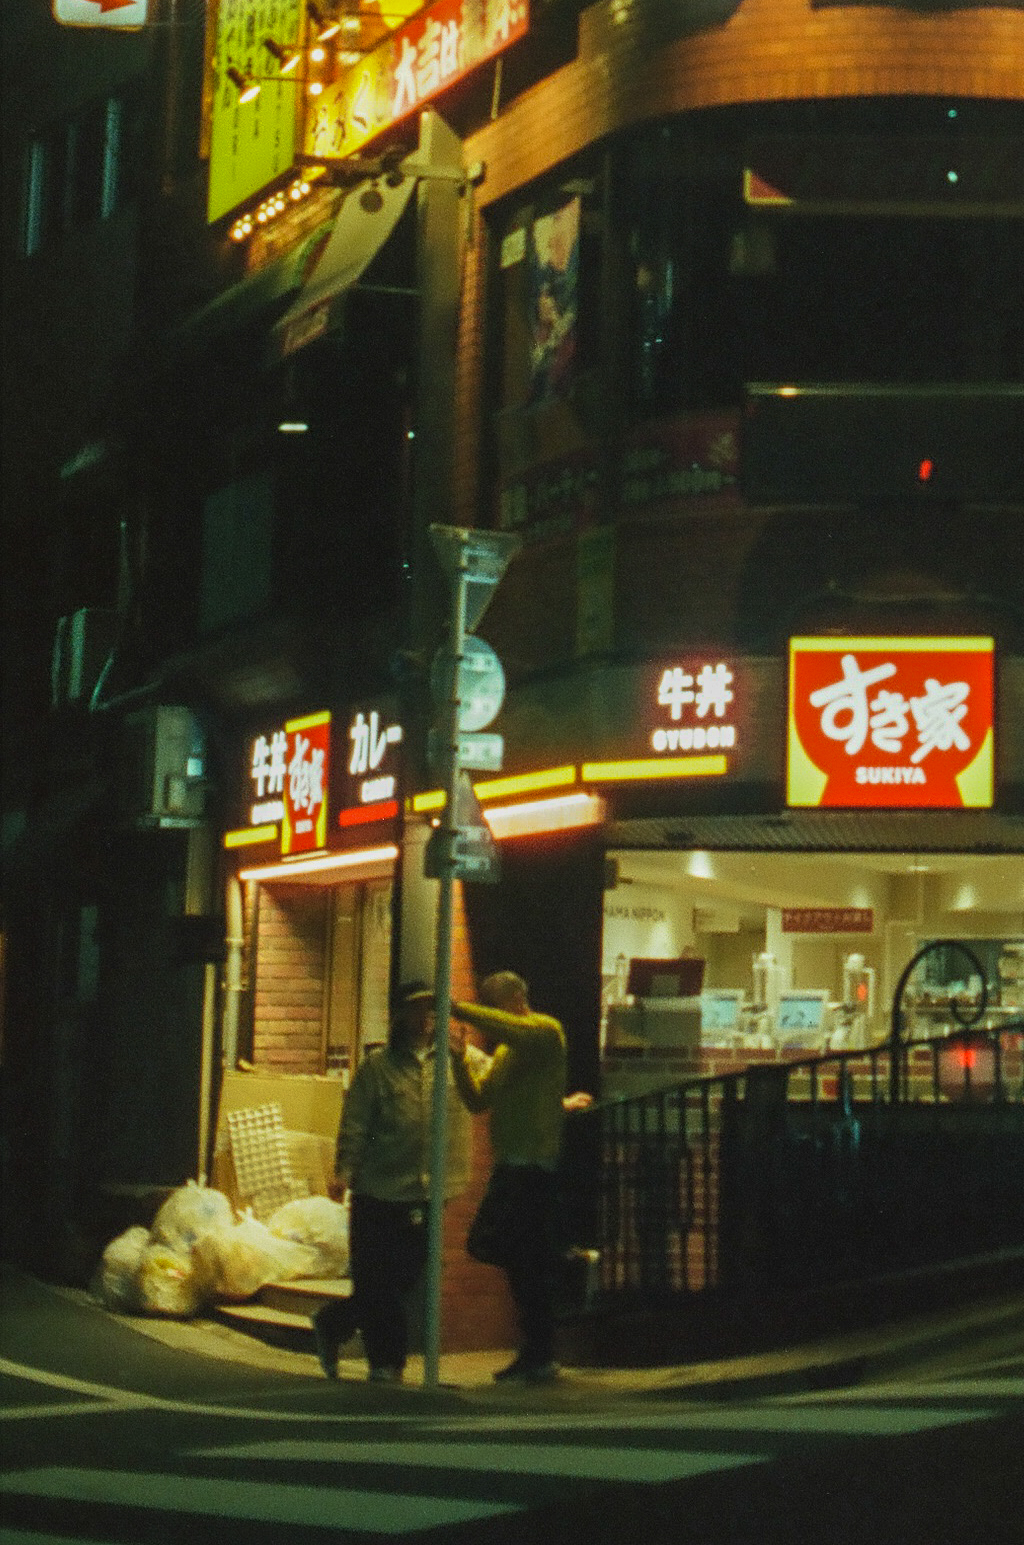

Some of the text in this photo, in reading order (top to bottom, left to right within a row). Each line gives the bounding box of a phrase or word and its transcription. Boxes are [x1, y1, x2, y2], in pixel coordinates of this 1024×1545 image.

[656, 663, 735, 720] 牛丼
[809, 654, 972, 764] すき家
[854, 766, 928, 786] SUKIYA
